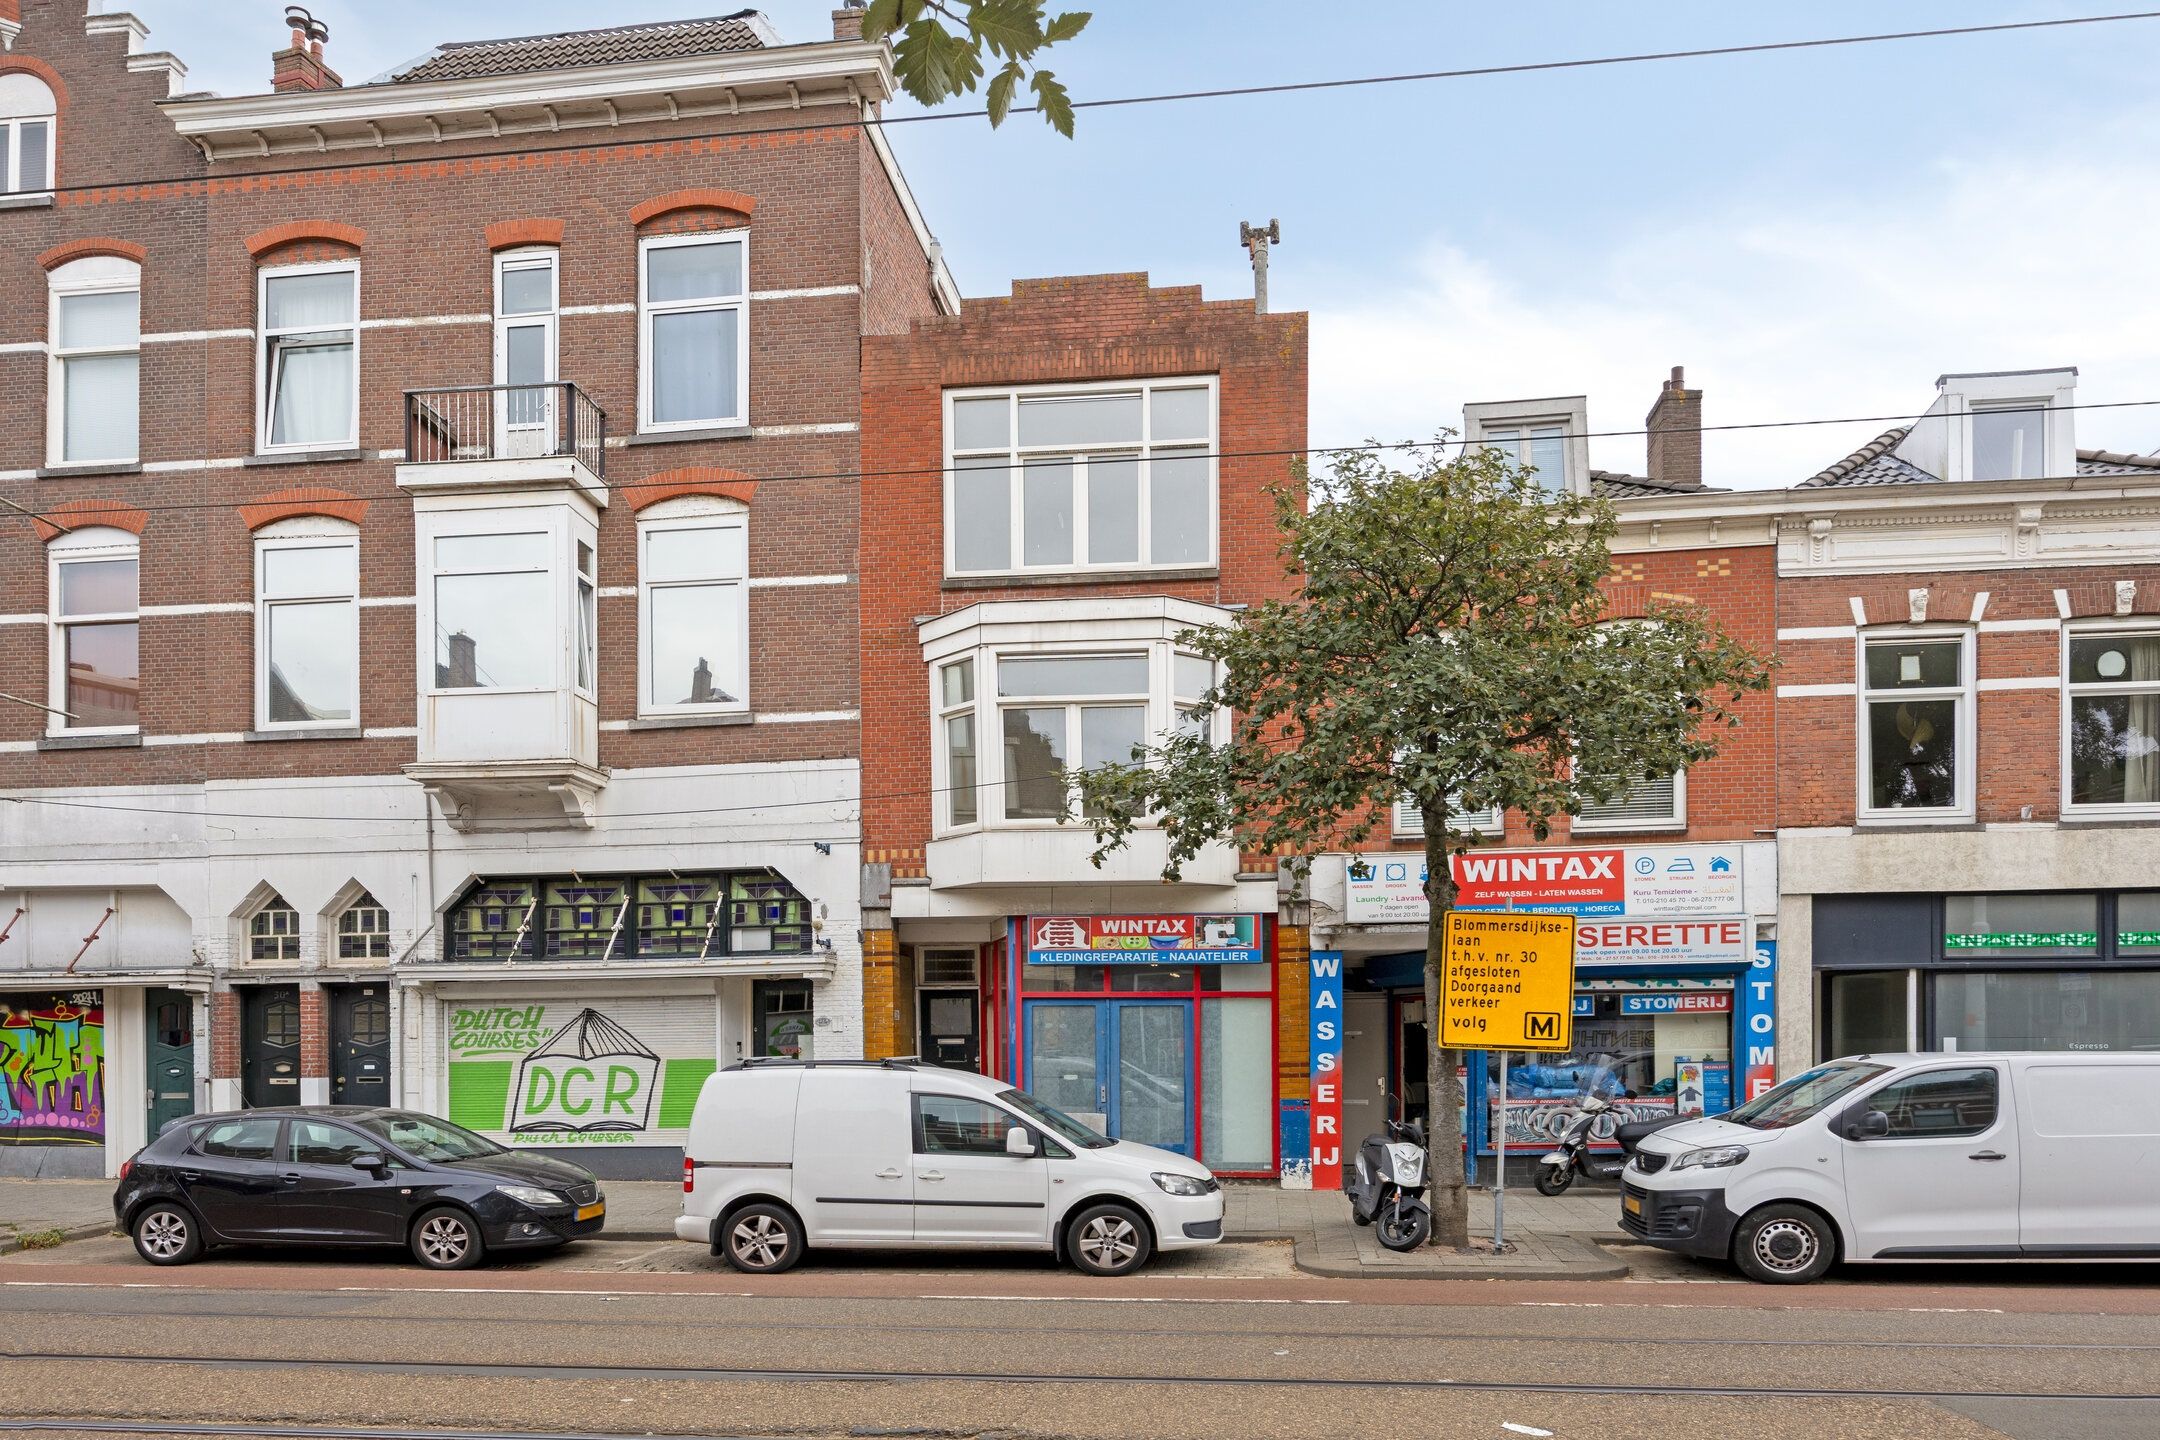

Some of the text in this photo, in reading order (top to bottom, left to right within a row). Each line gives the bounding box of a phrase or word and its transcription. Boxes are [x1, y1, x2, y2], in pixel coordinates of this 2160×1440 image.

[1462, 856, 1615, 883] WINTAX
[1497, 890, 1533, 898] WASSEN
[1539, 889, 1566, 897] LATEN
[1568, 888, 1604, 896] WASSEN
[1654, 888, 1692, 896] Temizleme
[1585, 905, 1621, 913] HORECA
[1101, 919, 1186, 934] WINTAX
[1454, 918, 1568, 936] Blommersdijkse-
[1452, 934, 1480, 946] laan
[1577, 922, 1741, 948] SERETTE
[1040, 952, 1159, 962] KLEDINGREPARATIE
[1169, 951, 1248, 962] NAAIATELIER
[1496, 952, 1513, 962] nr.
[1520, 951, 1538, 963] 30
[1451, 965, 1520, 980] afgesloten
[1452, 980, 1520, 996] Doorgaand
[1450, 996, 1500, 1008] verkeer
[1629, 996, 1727, 1010] STOMERIJ
[1452, 1016, 1486, 1032] volg
[1530, 1016, 1554, 1037] M
[1750, 949, 1774, 1098] STOME
[2068, 1042, 2109, 1050] Espresso
[1312, 959, 1340, 1165] WASSERIJ
[524, 1065, 640, 1116] DCR
